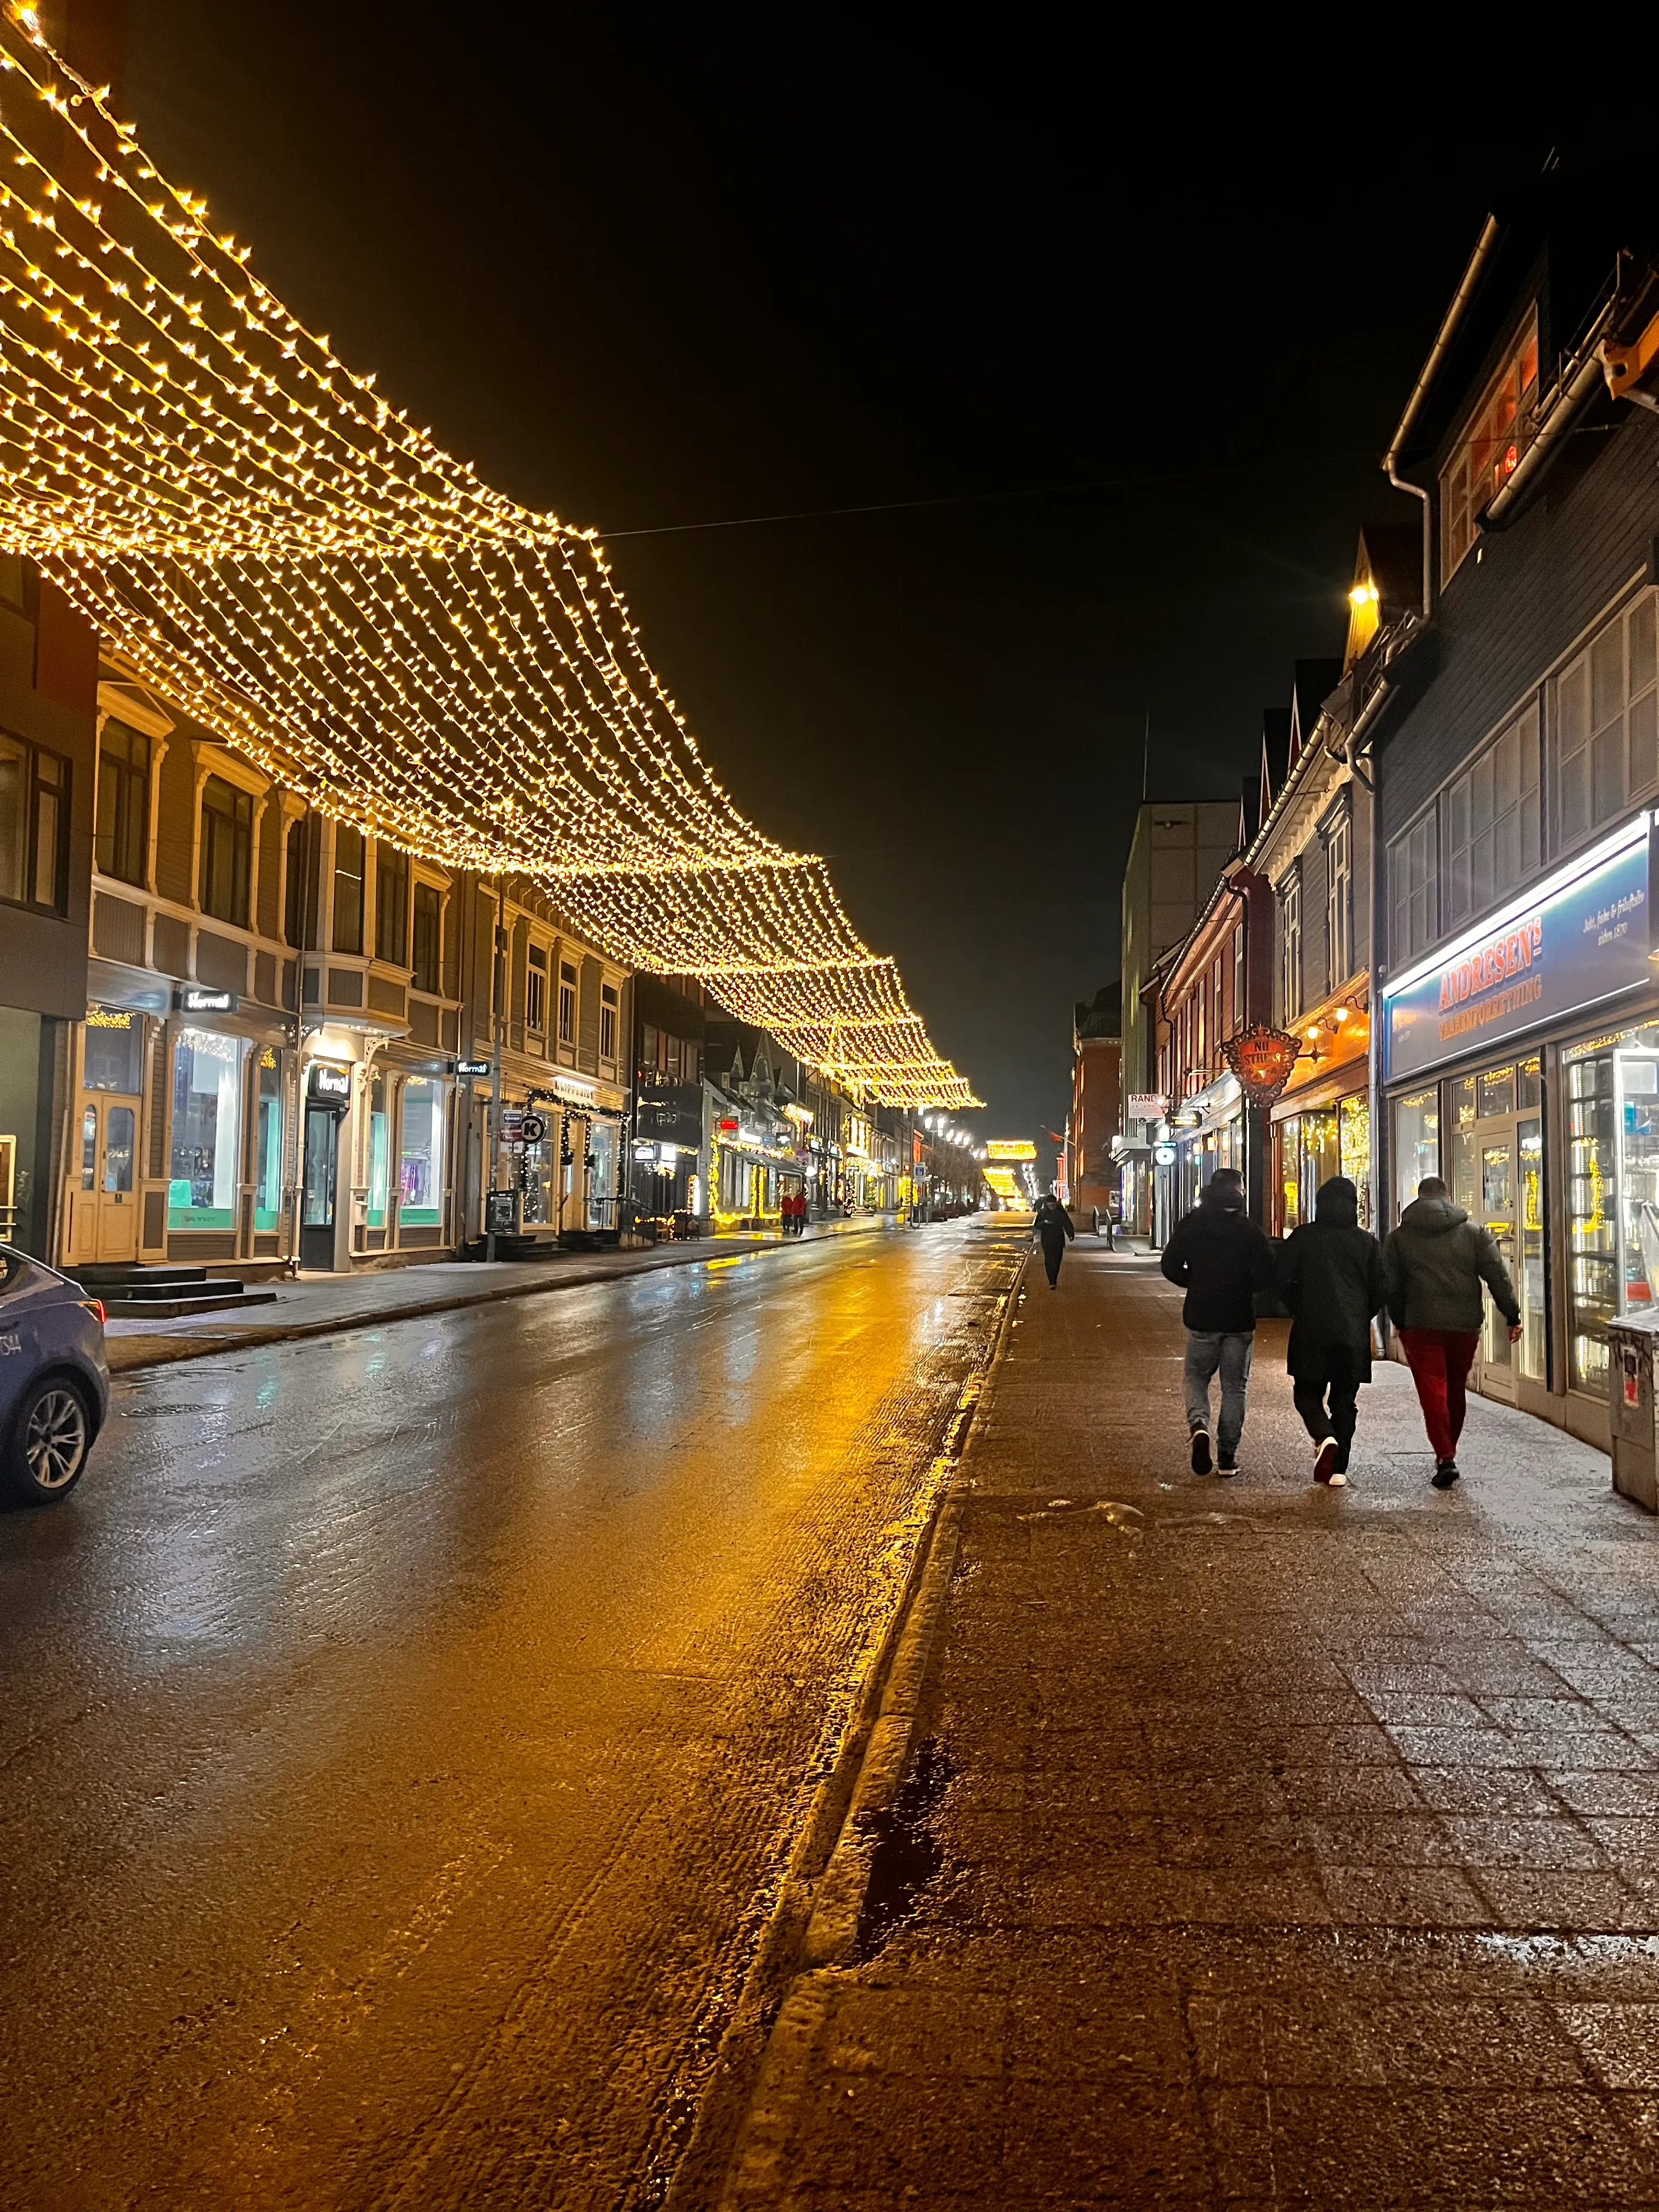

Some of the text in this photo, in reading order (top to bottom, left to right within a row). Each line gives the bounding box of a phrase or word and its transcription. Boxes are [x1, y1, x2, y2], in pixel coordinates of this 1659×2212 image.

[1597, 910, 1610, 930] fiske
[1611, 904, 1617, 918] &
[1617, 889, 1645, 919] friluftsliv
[1598, 922, 1628, 946] siden 1870
[188, 991, 229, 1008] Normal
[1255, 1042, 1269, 1052] NO
[458, 1062, 487, 1073] Normal
[319, 1068, 349, 1093] Normal
[524, 1122, 538, 1137] K
